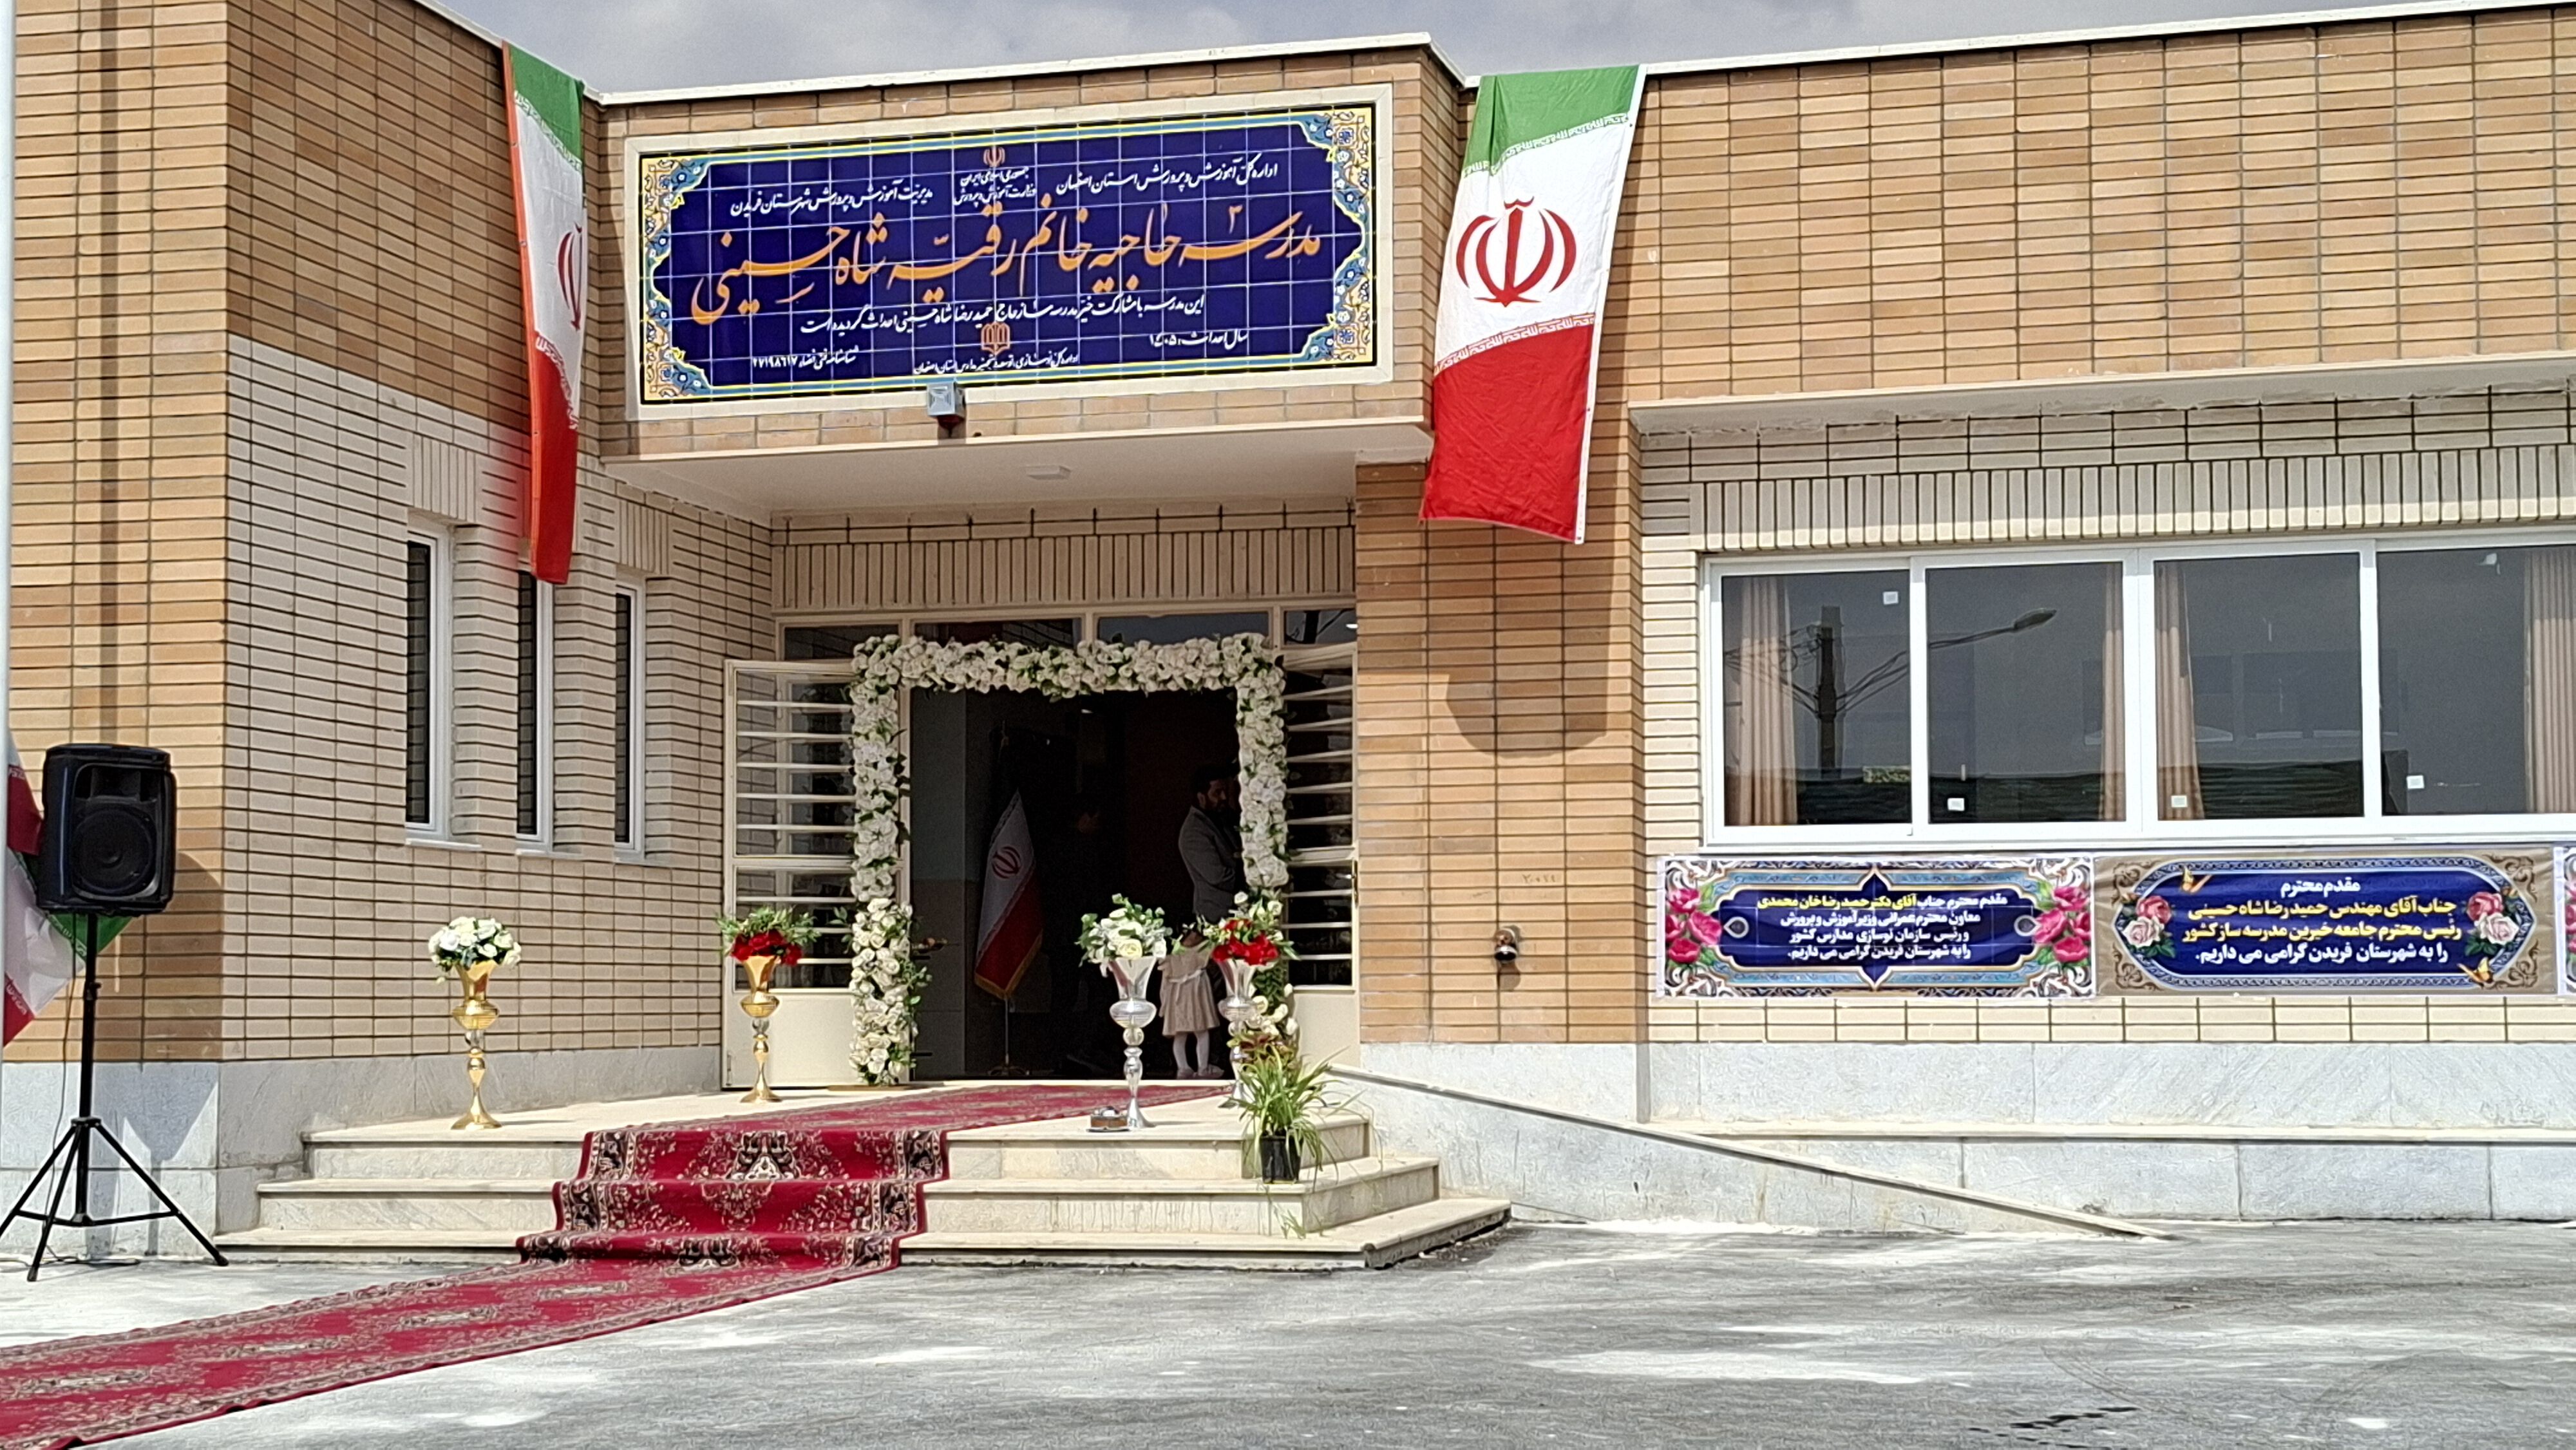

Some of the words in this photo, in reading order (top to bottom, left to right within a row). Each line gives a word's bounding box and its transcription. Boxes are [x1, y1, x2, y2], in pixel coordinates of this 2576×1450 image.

[1137, 164, 1185, 192] پرورش
[1188, 156, 1243, 187] آموزش
[1251, 163, 1278, 178] اداره
[1056, 171, 1092, 194] اصفهان
[1091, 172, 1138, 193] استان
[760, 188, 810, 215] شهرستان
[809, 187, 849, 212] پرورش
[852, 178, 904, 208] آموزش
[898, 184, 933, 204] مدیریت
[730, 191, 762, 217] فریدن
[1019, 193, 1093, 297] خانم
[1179, 206, 1321, 267] مدرسه
[835, 212, 888, 285] شاه
[1088, 203, 1182, 292] حاجیه
[691, 226, 850, 325] حسینی
[996, 303, 1017, 321] حاج
[1091, 292, 1137, 315] مشارکت
[1144, 296, 1184, 312] مدرسه
[1184, 294, 1204, 315] این
[833, 304, 870, 336] گردیده
[861, 312, 897, 329] احداث
[896, 308, 936, 333] حسینی
[934, 302, 952, 324] شاه
[954, 304, 973, 322] رضا
[972, 306, 994, 328] حمید
[800, 314, 833, 334] است
[1224, 328, 1249, 350] سال
[2280, 880, 2323, 898] محترم
[2324, 877, 2361, 898] مقدم
[1757, 897, 1799, 909] محمدی
[1799, 895, 1822, 909] خان
[1823, 895, 1841, 910] رضا
[1869, 896, 1891, 910] دکتر
[1891, 893, 1917, 910] آقای
[1917, 895, 1946, 909] جناب
[1947, 897, 1979, 910] محترم
[1979, 893, 2008, 909] مقدم
[2239, 899, 2264, 915] شاه
[2265, 899, 2289, 919] رضا
[2383, 895, 2418, 918] آقای
[2418, 898, 2457, 917] جناب
[1780, 912, 1817, 927] پرورش
[1823, 907, 1858, 927] آموزش
[1878, 912, 1915, 927] عمرانی
[1948, 910, 1981, 926] معاون
[2188, 903, 2238, 920] حسینی
[2290, 903, 2329, 918] حمید
[2329, 902, 2383, 919] مهندس
[1855, 914, 1877, 927] وزیر
[1916, 913, 1948, 927] محترم
[1789, 928, 1817, 943] کشور
[1816, 928, 1854, 943] مدارس
[1856, 928, 1893, 943] نوسازی
[1895, 928, 1931, 943] سازمان
[2182, 922, 2218, 942] کشور
[2217, 922, 2242, 941] ساز
[2242, 925, 2287, 941] مدرسه
[2289, 921, 2333, 941] خیرین
[2334, 921, 2378, 940] جامعه
[2378, 924, 2423, 941] محترم
[1819, 949, 1837, 960] می
[1838, 944, 1871, 960] گرامی
[1871, 945, 1904, 959] فریدن
[1905, 945, 1950, 959] شهرستان
[1951, 946, 1962, 958] به
[1962, 943, 1971, 959] را
[2239, 949, 2262, 964] می
[2264, 942, 2308, 964] گرامی
[2309, 941, 2353, 963] فریدن
[2356, 942, 2416, 963] شهرستان
[2418, 945, 2434, 962] به
[2436, 942, 2448, 963] را
